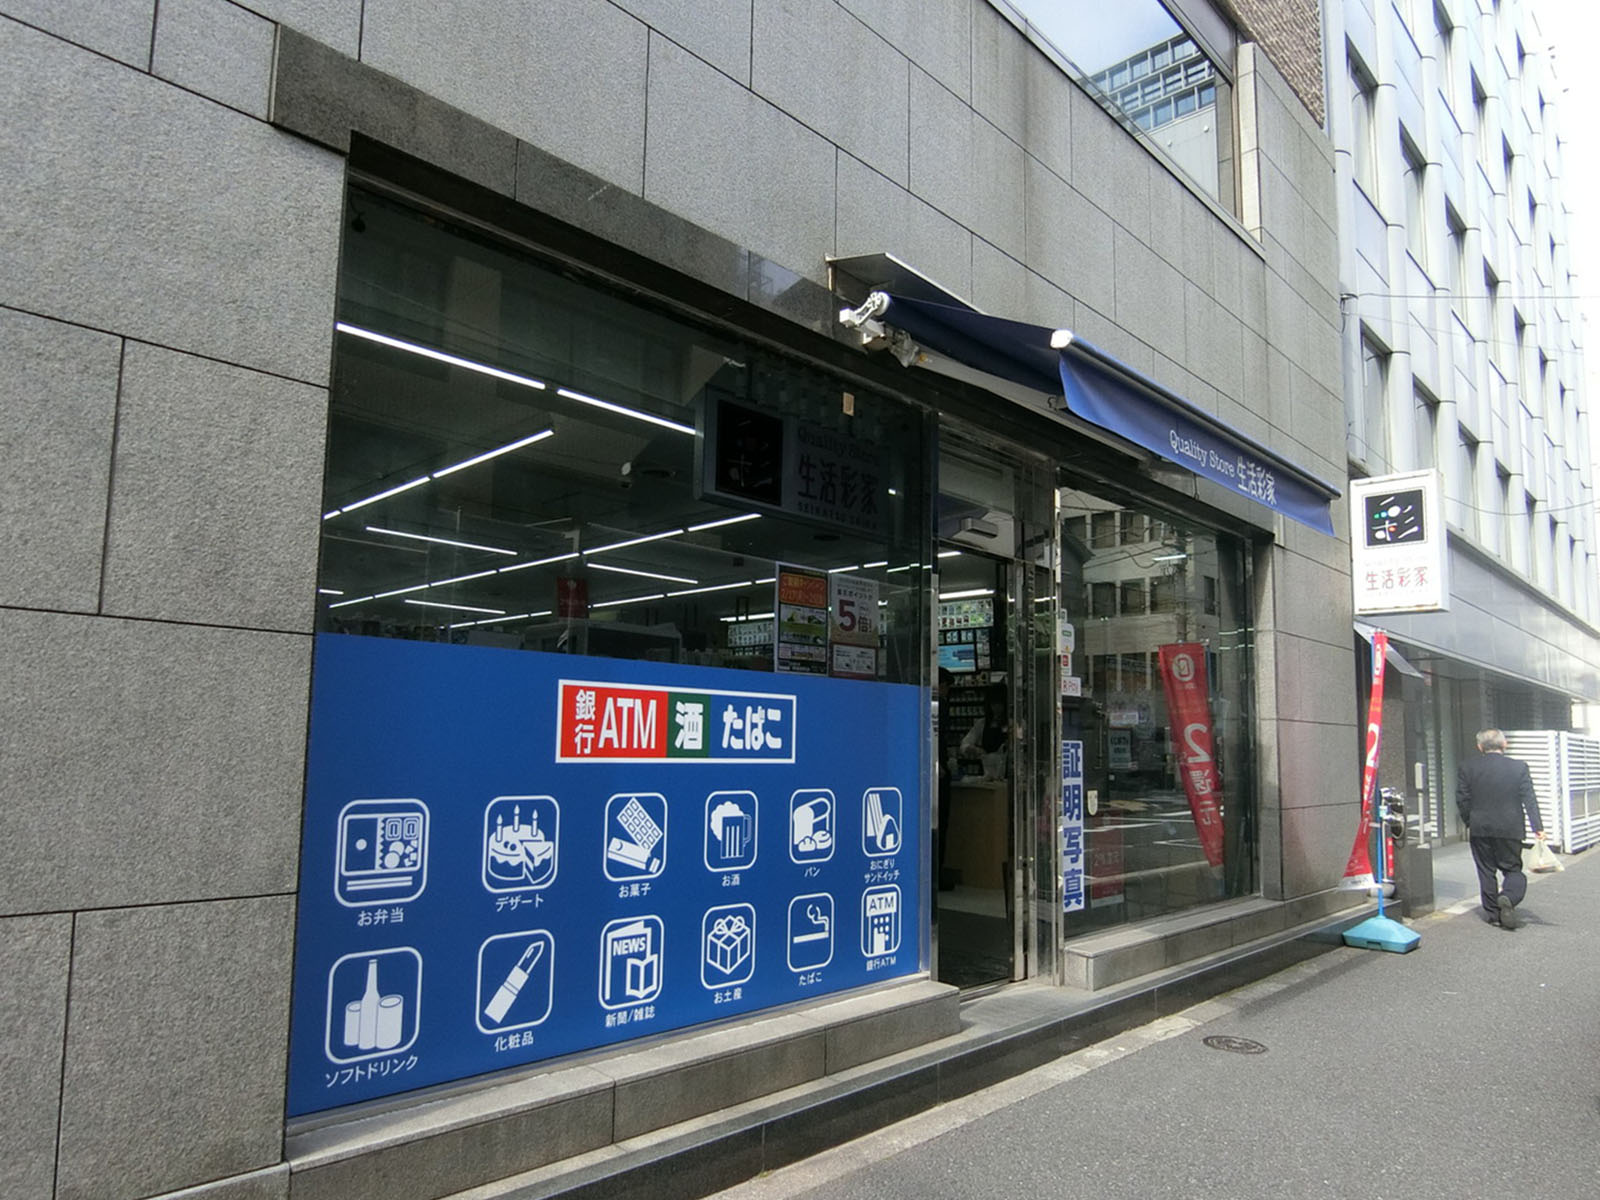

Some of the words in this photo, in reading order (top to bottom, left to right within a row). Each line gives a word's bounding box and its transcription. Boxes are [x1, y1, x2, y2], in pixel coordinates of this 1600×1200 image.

[1169, 429, 1208, 467] Quality
[1209, 449, 1236, 478] Store
[1236, 455, 1278, 505] 生活彩家
[798, 454, 878, 514] 生活彩家
[1366, 566, 1430, 591] 生活彩家
[574, 689, 596, 755] 銀行
[598, 697, 657, 750] ATM
[674, 701, 704, 750] 酒
[722, 703, 782, 751] たばこ
[1062, 741, 1083, 909] 証明写真
[804, 866, 820, 878] パン
[869, 858, 895, 870] おにぎり
[721, 873, 741, 887] お酒
[864, 871, 901, 884] サンドイッチ
[618, 882, 652, 899] お菓子
[495, 893, 544, 913] デザート
[868, 895, 895, 912] ATM
[357, 907, 404, 927] お弁当
[612, 936, 647, 957] NEWS
[866, 956, 897, 972] 銀行ATM
[798, 972, 823, 987] たばこ
[713, 987, 742, 1005] お土産
[494, 1030, 534, 1053] 化粧品
[325, 1054, 419, 1088] ソフトドリンク
